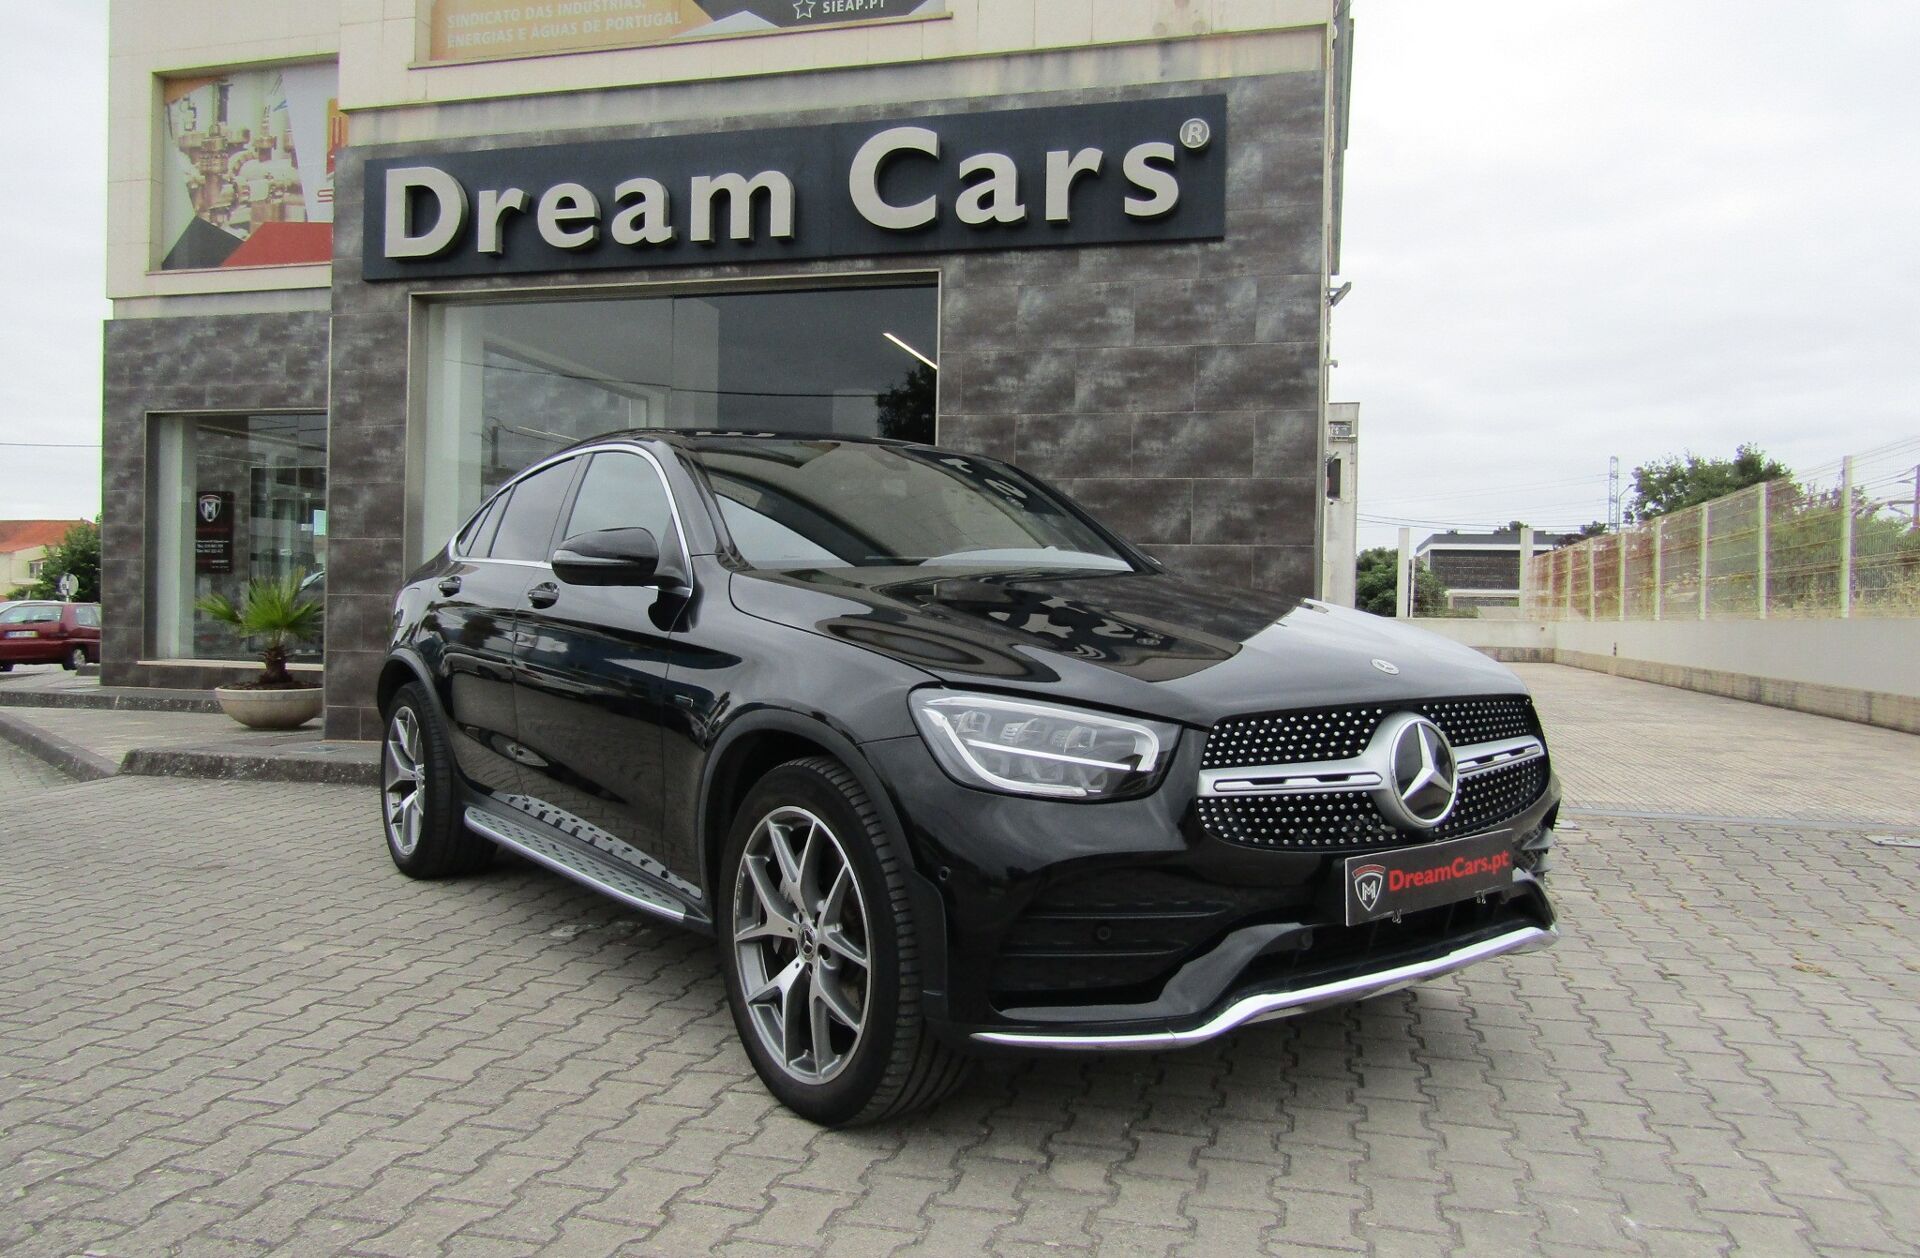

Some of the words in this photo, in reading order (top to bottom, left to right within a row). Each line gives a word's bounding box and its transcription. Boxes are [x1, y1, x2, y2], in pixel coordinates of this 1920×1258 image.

[447, 8, 520, 29] SINDICATO
[525, 3, 553, 19] DAS
[447, 28, 513, 49] ENERGIAS
[518, 28, 528, 40] E
[531, 22, 577, 40] ÁGUAS
[583, 19, 601, 33] DE
[606, 11, 682, 31] PORTUGAL
[384, 165, 796, 259] Dream
[1389, 850, 1510, 891] DreamCars.pt
